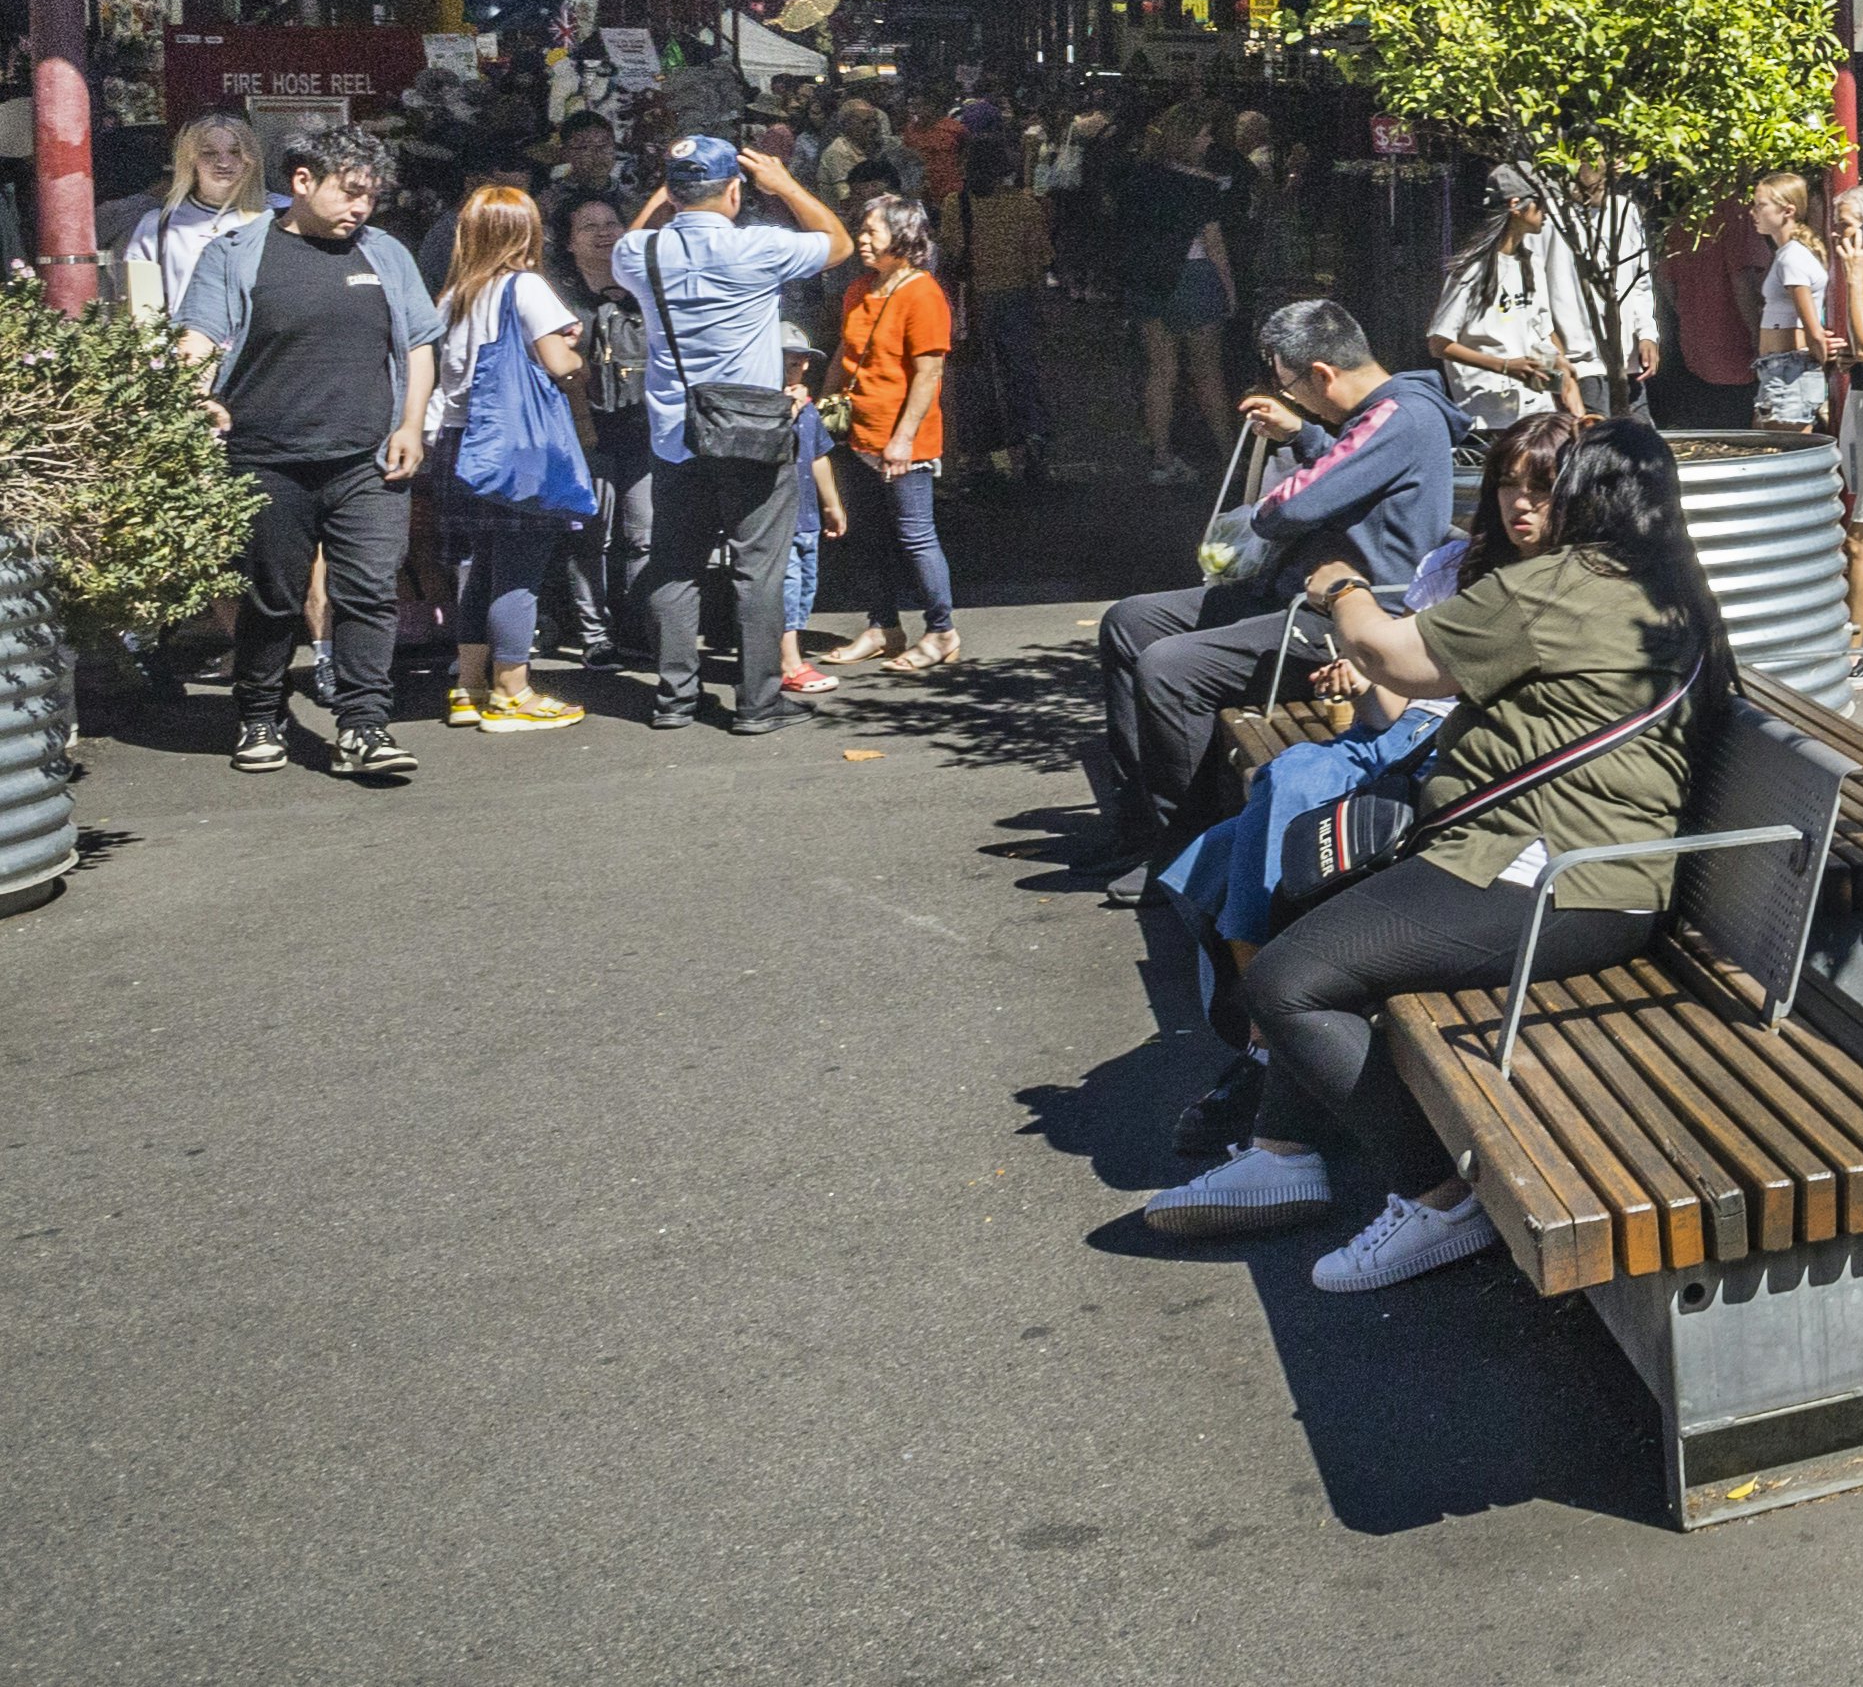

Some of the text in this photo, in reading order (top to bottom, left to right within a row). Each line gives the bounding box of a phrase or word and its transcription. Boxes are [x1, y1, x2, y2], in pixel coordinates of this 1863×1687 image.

[223, 73, 376, 95] FIRE HOSE REEL
[1319, 817, 1334, 877] HILFIGER
